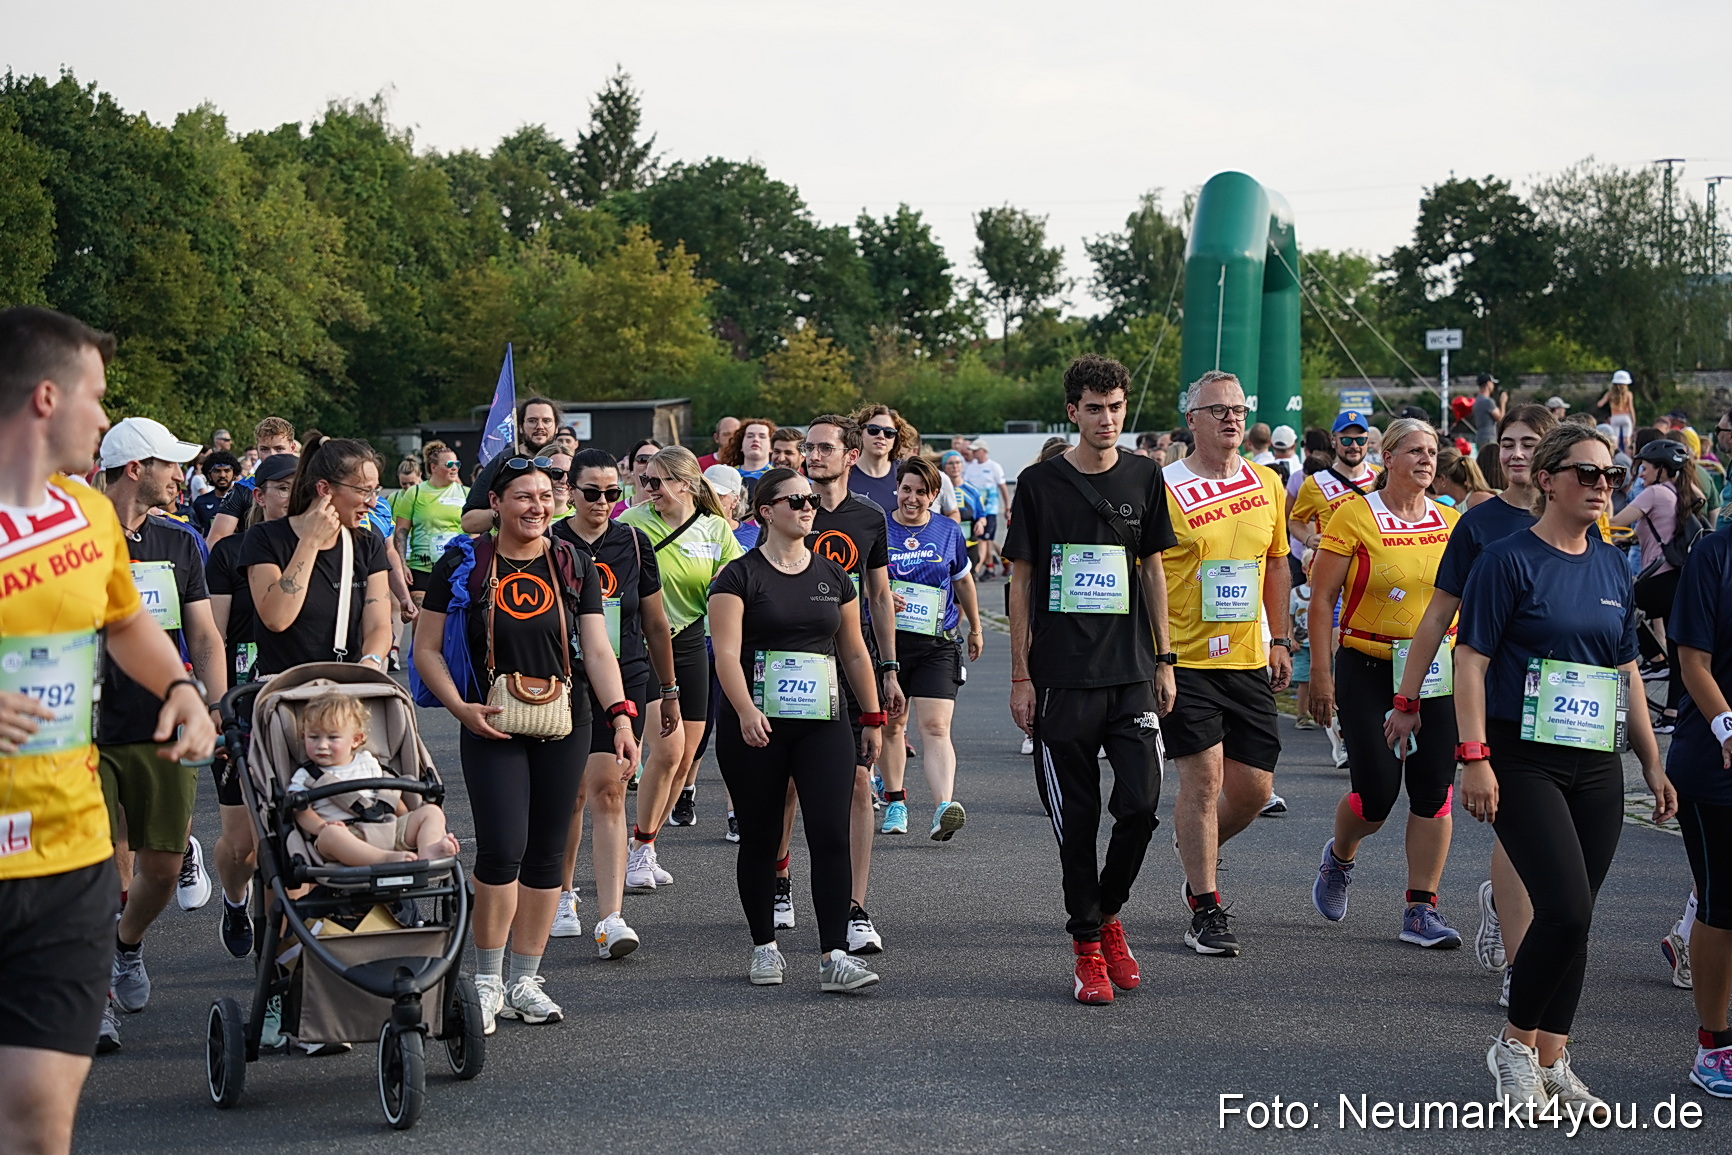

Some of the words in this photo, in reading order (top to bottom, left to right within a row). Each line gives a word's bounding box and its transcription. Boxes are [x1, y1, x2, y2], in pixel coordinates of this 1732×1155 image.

[1187, 507, 1228, 530] MAX
[1228, 494, 1270, 516] BÖGL
[1382, 537, 1416, 547] MAX
[48, 540, 103, 578] BÖGL
[1074, 573, 1116, 588] 2749
[1069, 589, 1092, 597] Konrad
[1092, 590, 1122, 598] Haarmann
[1215, 585, 1248, 598] 1867
[904, 602, 929, 616] 856
[777, 679, 817, 694] 2747
[779, 695, 797, 703] Maria
[1554, 696, 1600, 717] 2479
[1547, 716, 1576, 726] Jennifer
[1577, 721, 1605, 730] Hofmann
